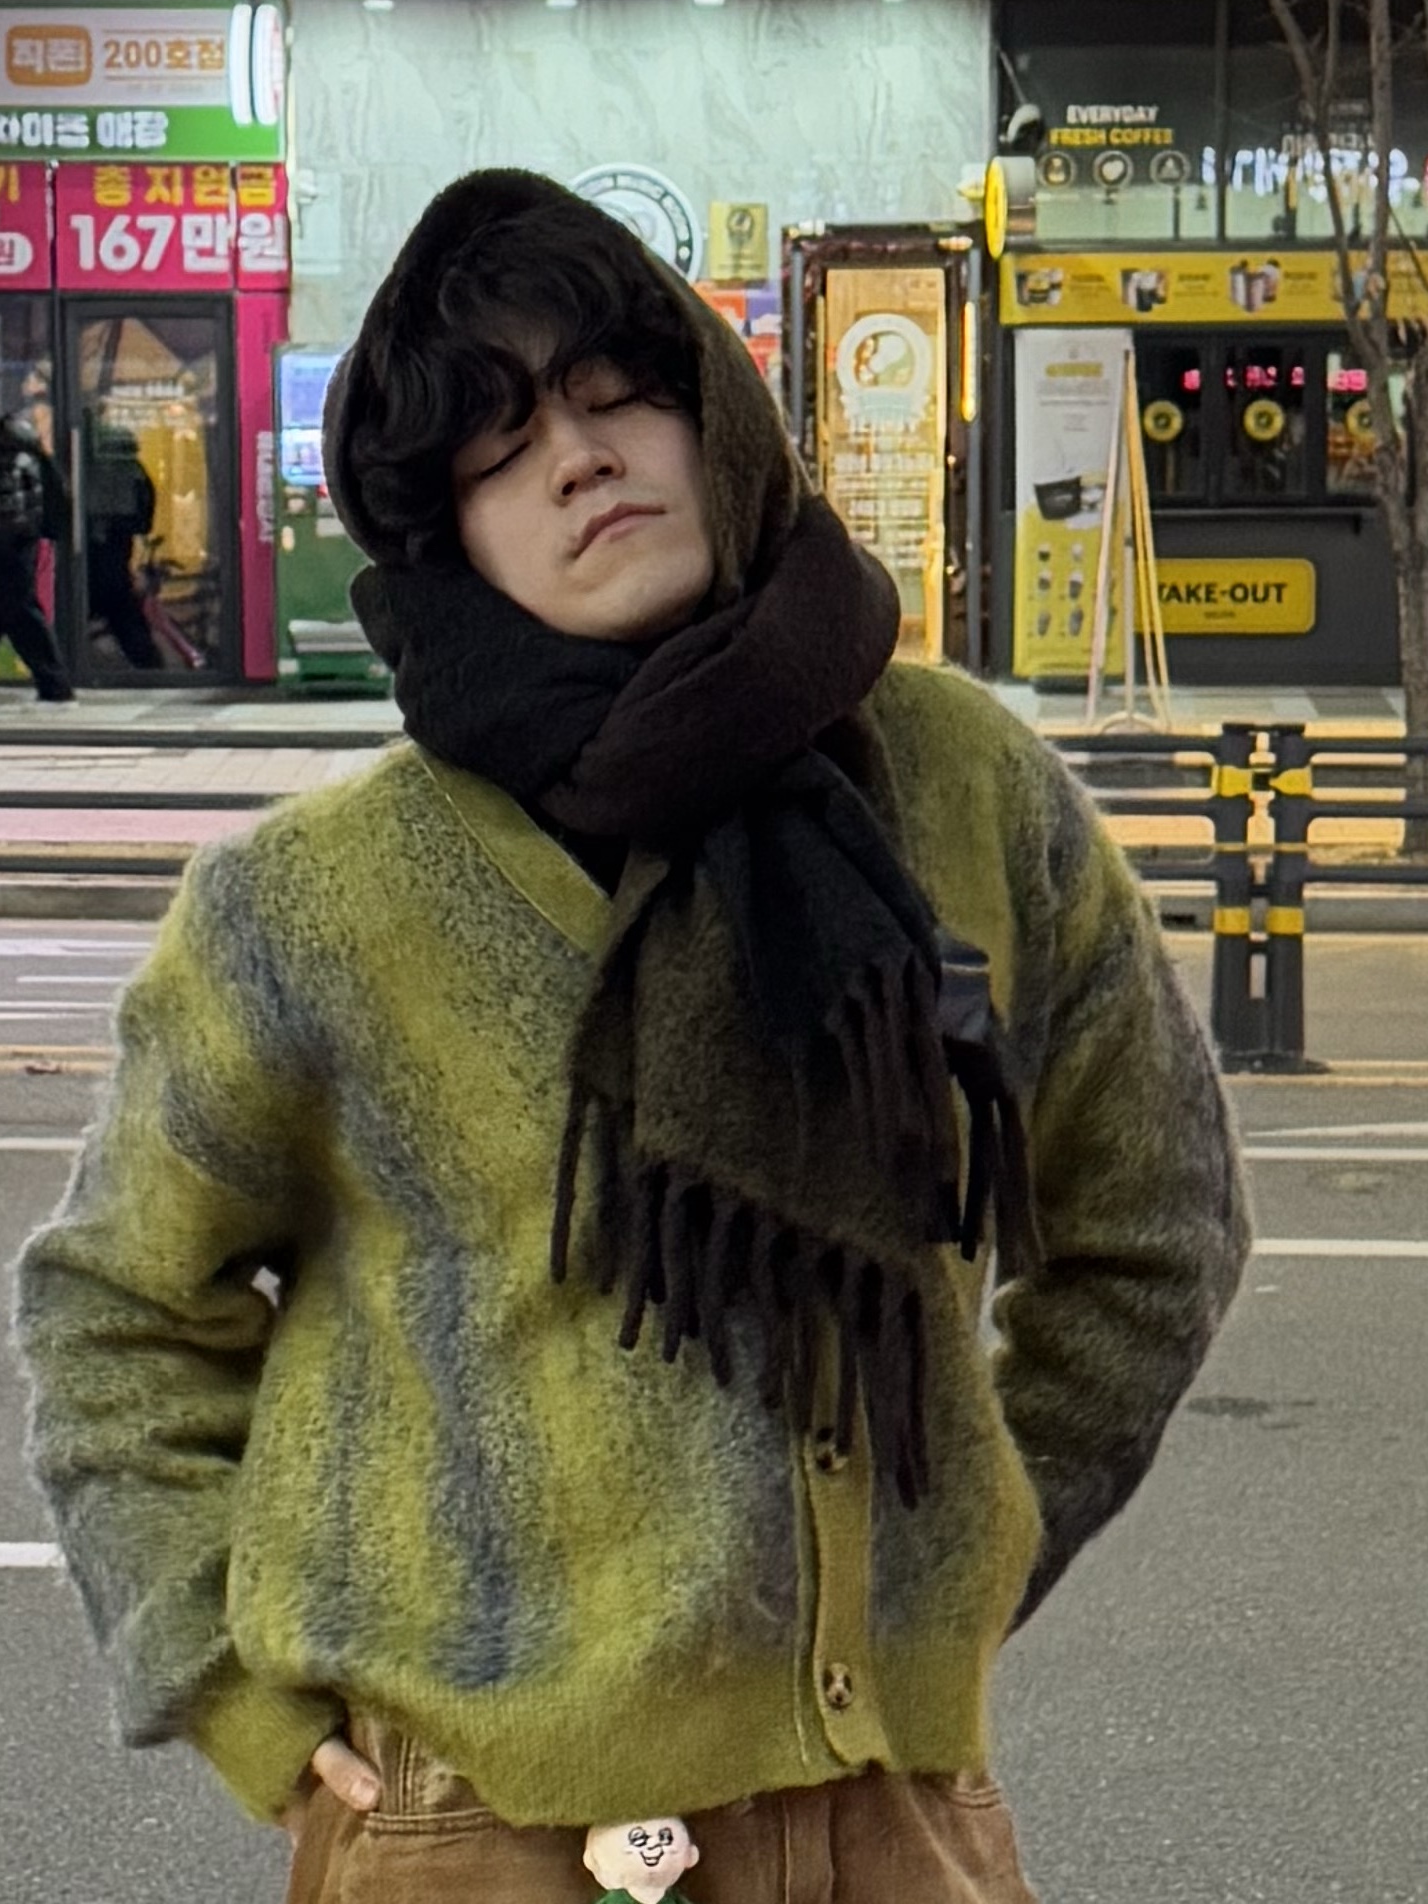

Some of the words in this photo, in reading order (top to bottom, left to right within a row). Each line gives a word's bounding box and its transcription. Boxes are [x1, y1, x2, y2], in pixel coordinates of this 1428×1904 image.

[1109, 127, 1174, 146] COFFEE
[92, 165, 133, 207] 총
[68, 212, 290, 274] 167만원
[1158, 582, 1288, 605] TAKE-OUT
